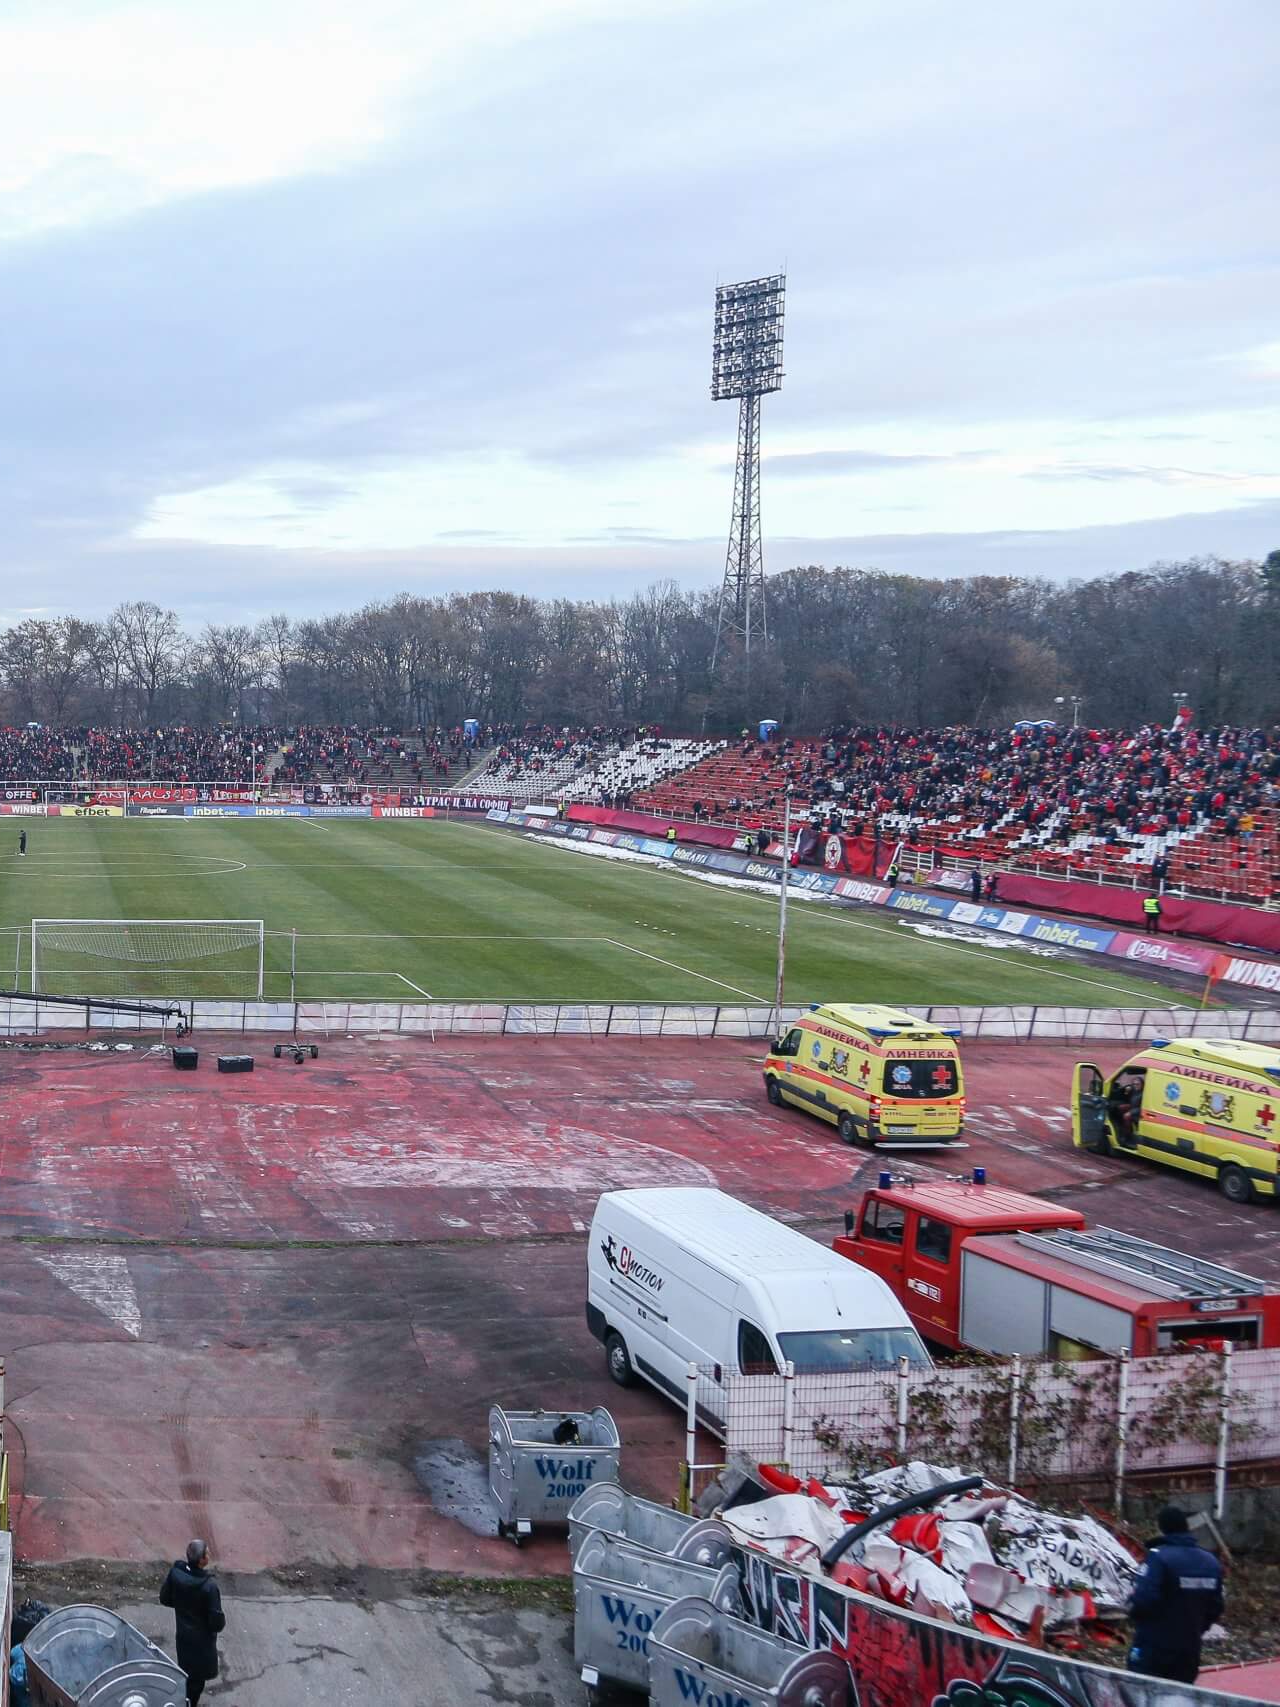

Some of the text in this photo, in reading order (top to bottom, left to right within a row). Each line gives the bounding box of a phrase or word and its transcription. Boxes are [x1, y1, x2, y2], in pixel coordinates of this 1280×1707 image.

[11, 804, 48, 814] WINBET
[74, 807, 110, 816] efbet
[381, 807, 425, 817] WINBET
[842, 879, 883, 902] WINBET
[1224, 958, 1280, 991] WINB
[534, 1459, 597, 1480] Wolf
[546, 1483, 586, 1498] 2009
